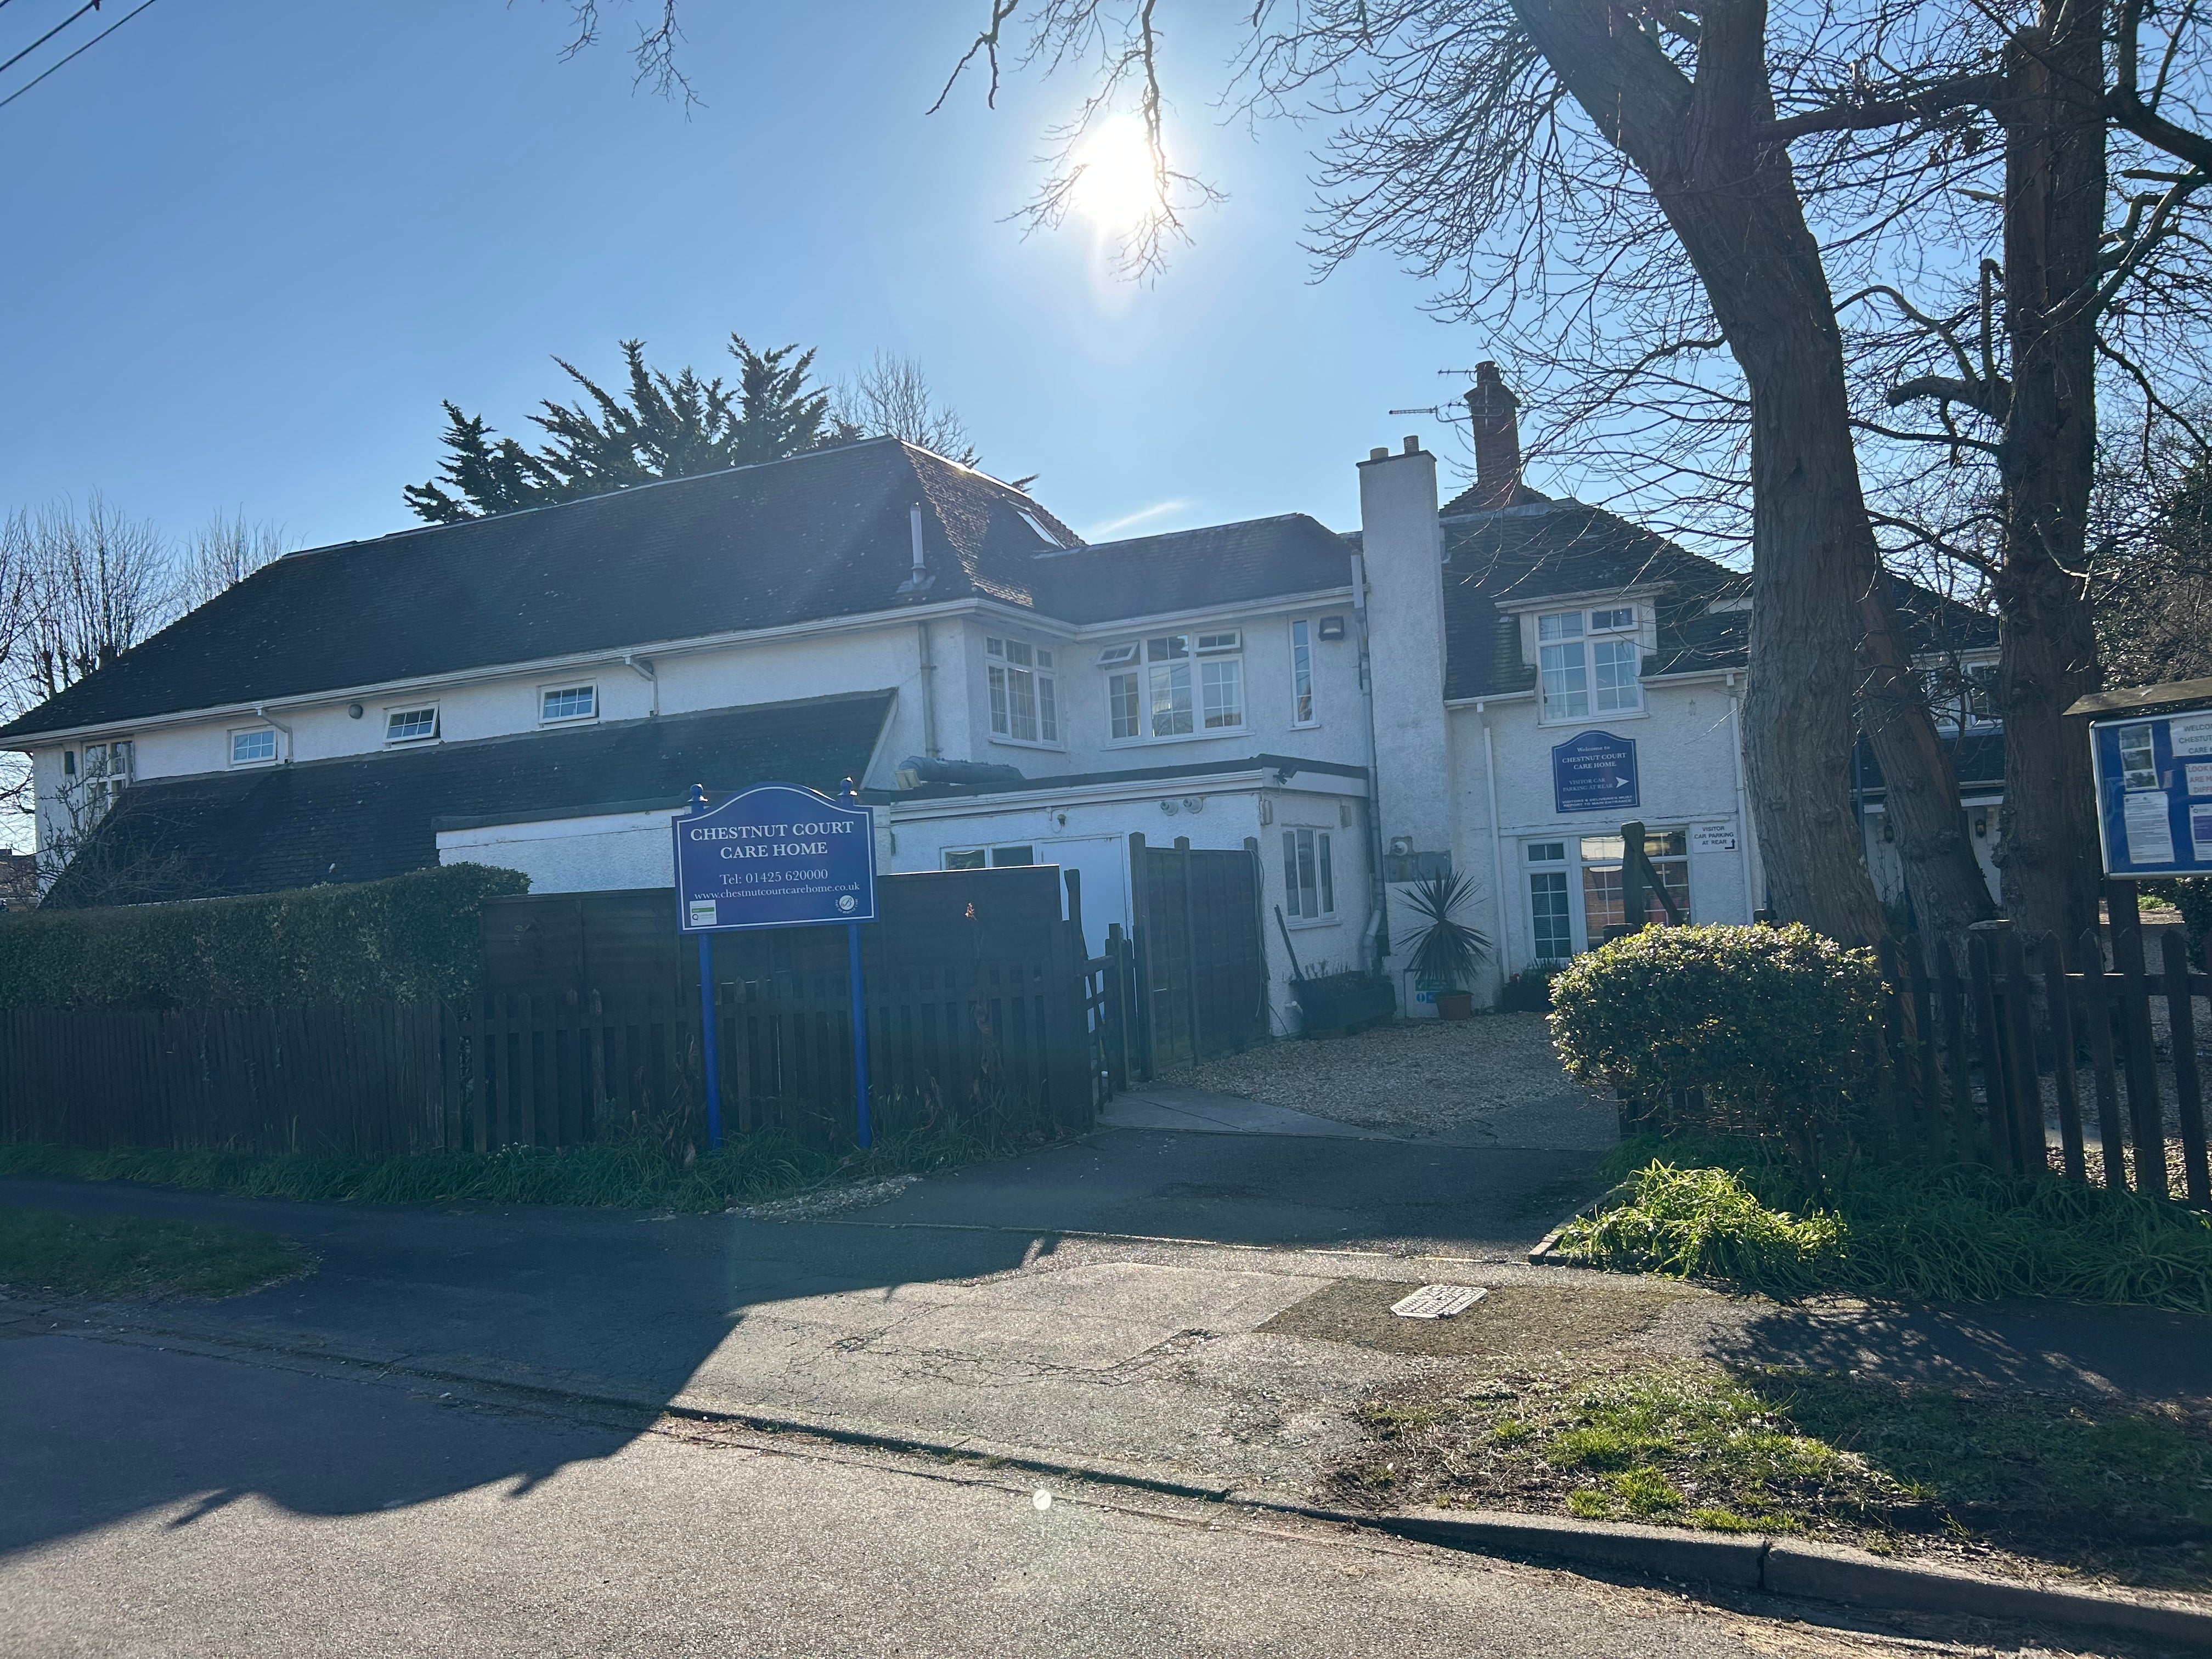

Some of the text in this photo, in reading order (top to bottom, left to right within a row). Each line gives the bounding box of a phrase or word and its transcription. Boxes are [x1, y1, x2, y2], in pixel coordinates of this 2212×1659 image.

[2184, 724, 2212, 732] WELCO
[1562, 755, 1600, 763] CHESTNUT
[690, 821, 854, 841] CHESTNUT COURT
[720, 842, 828, 859] CARE HOME
[719, 869, 828, 885] Tel: 01425 620000
[695, 882, 860, 900] www.chestnutcourtcarehome.co.uk
